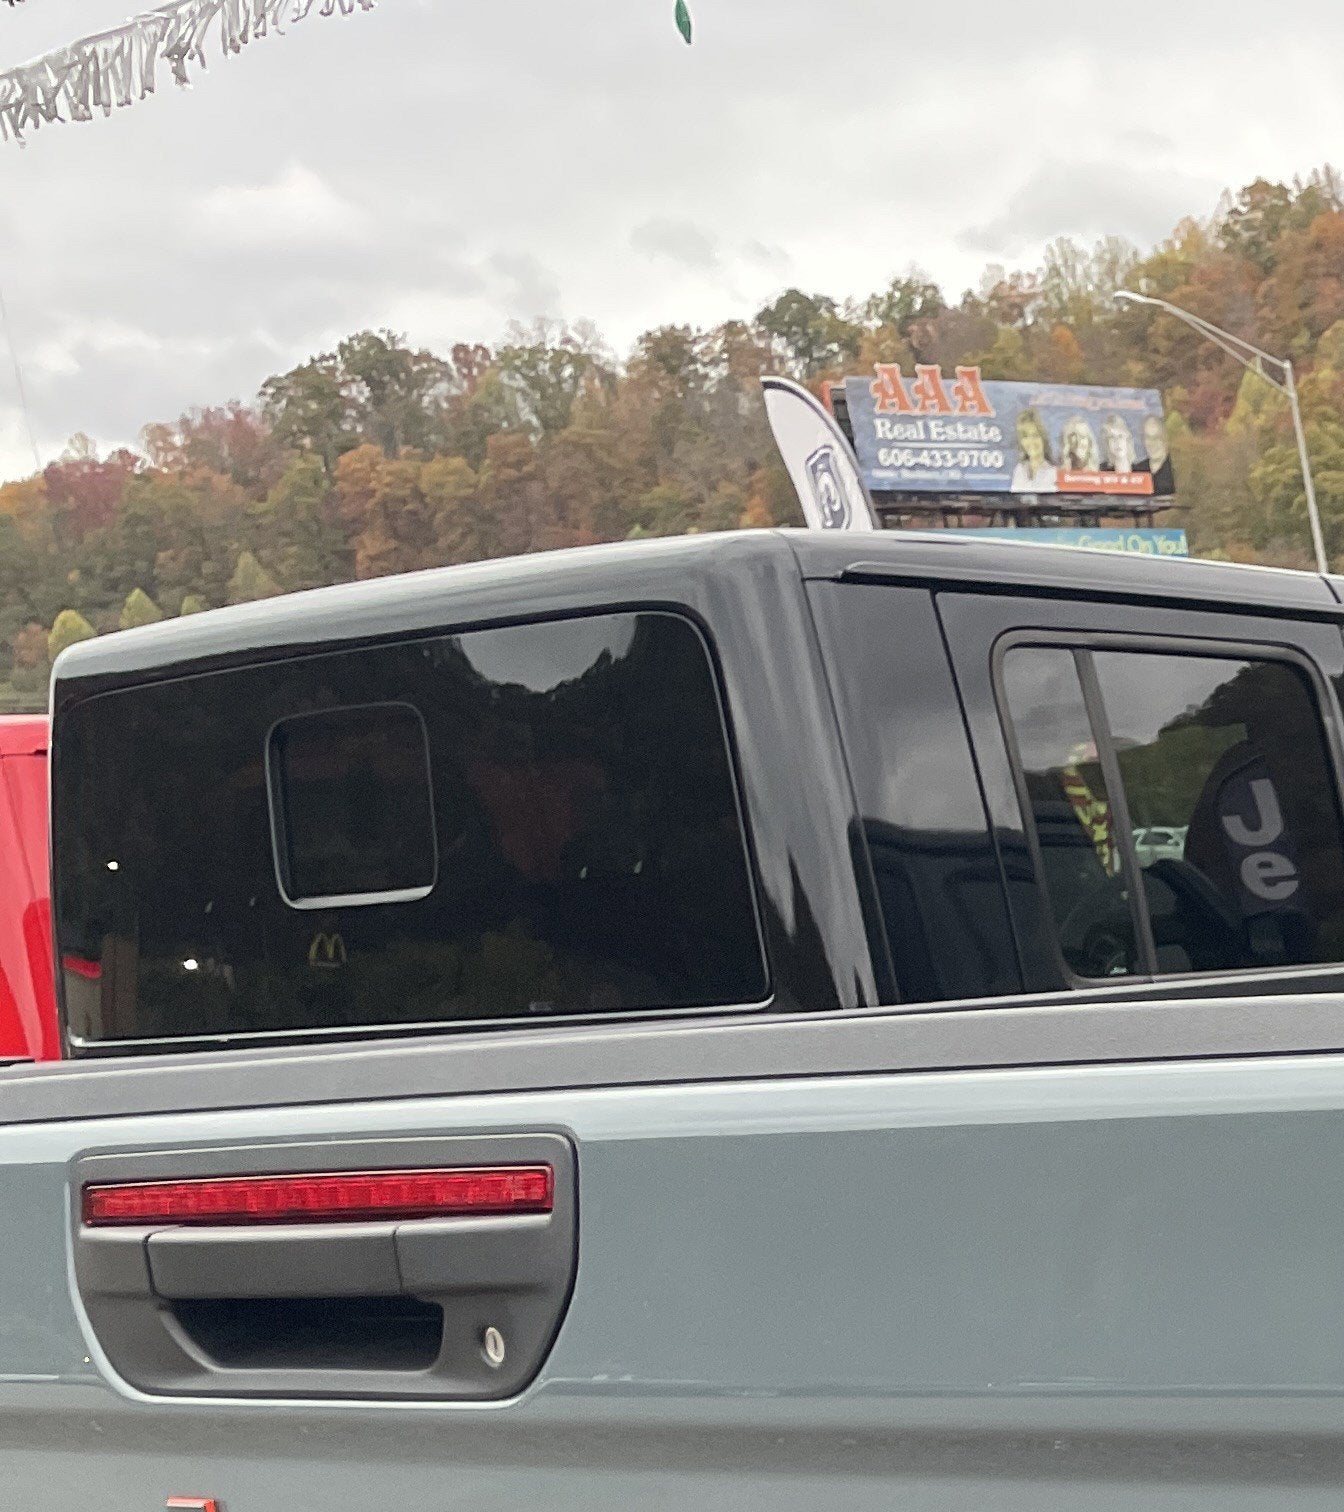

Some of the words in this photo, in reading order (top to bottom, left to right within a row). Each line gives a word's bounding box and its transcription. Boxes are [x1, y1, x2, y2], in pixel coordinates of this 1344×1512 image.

[870, 362, 997, 417] AAA
[873, 418, 926, 440] Real
[928, 420, 1003, 443] Estate
